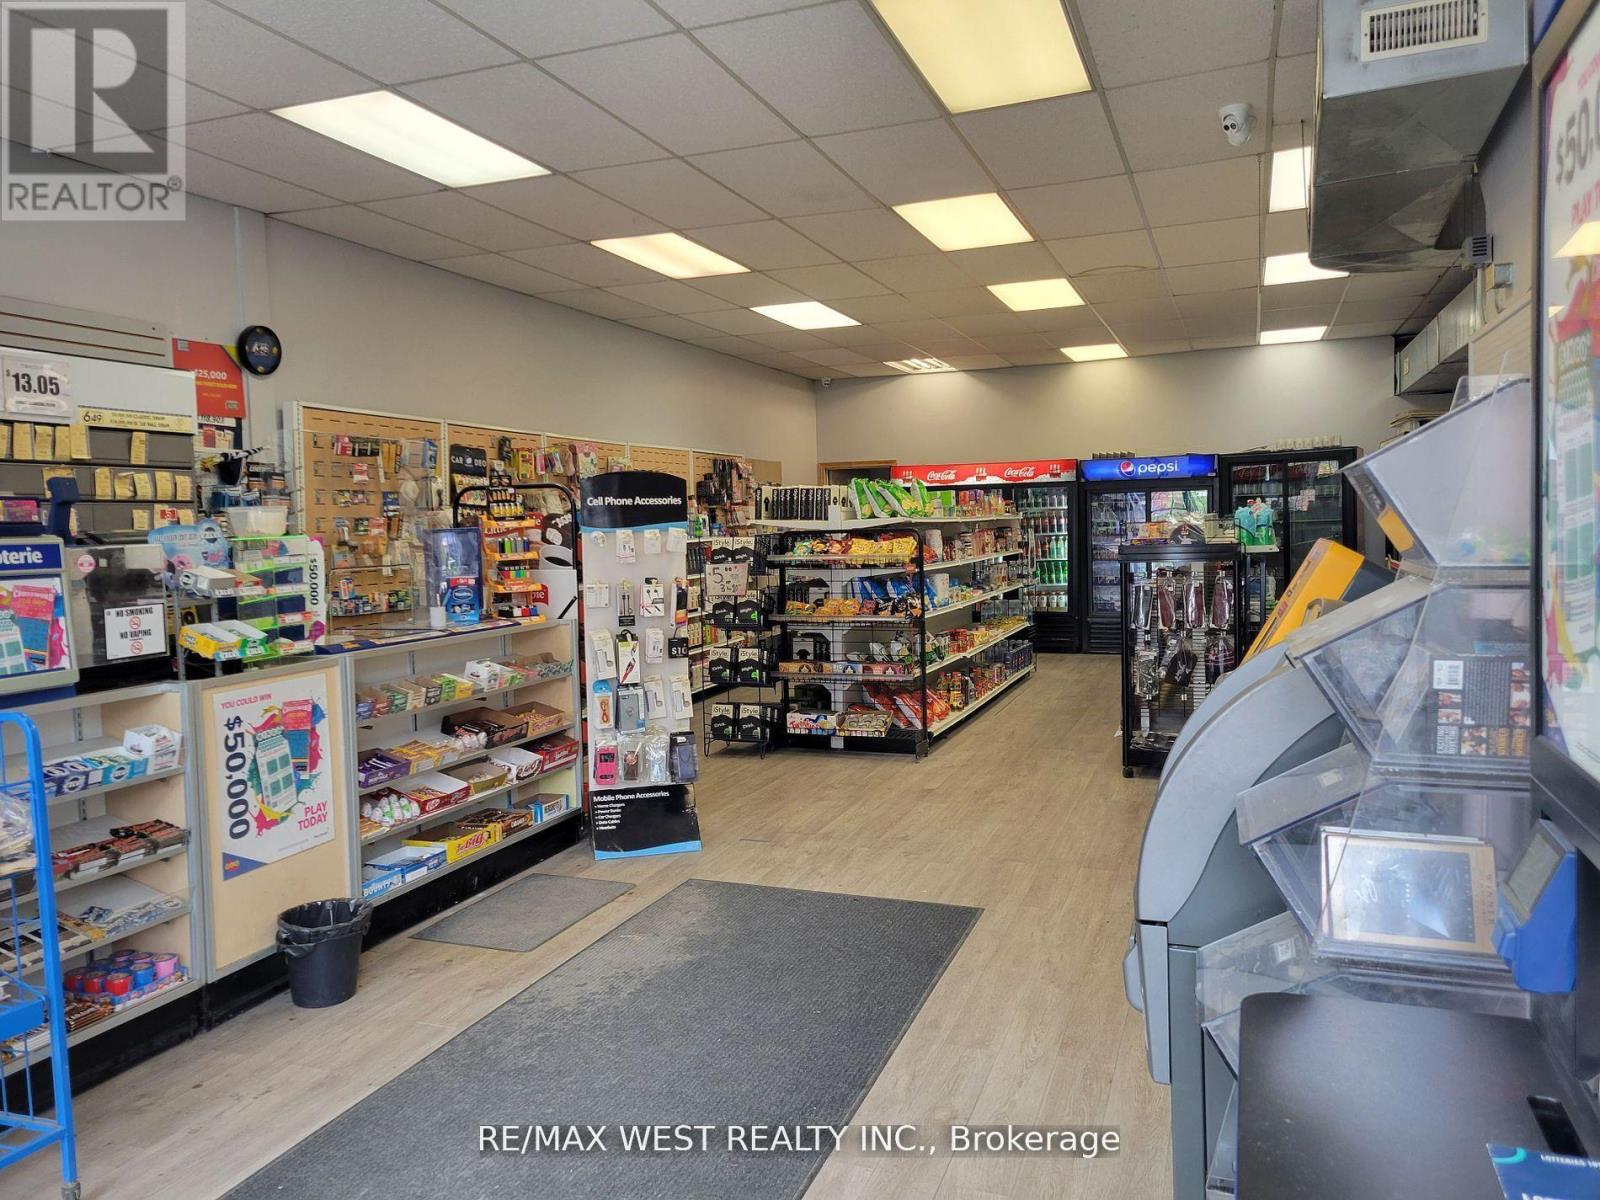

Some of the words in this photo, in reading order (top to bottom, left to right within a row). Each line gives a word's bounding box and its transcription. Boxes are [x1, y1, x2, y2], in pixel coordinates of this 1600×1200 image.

[1138, 460, 1178, 476] pepsi
[587, 496, 603, 506] Cell
[604, 496, 633, 506] Phone
[634, 495, 682, 505] Accessories
[0, 546, 43, 565] terie
[125, 606, 154, 617] SMOKING
[130, 628, 152, 638] VAPING
[220, 701, 236, 710] YOU
[236, 696, 258, 707] COULD
[259, 693, 272, 702] WIN
[224, 715, 250, 840] $50,000
[636, 790, 670, 799] Accessories
[304, 801, 328, 818] PLAY
[298, 812, 328, 831] TODAY
